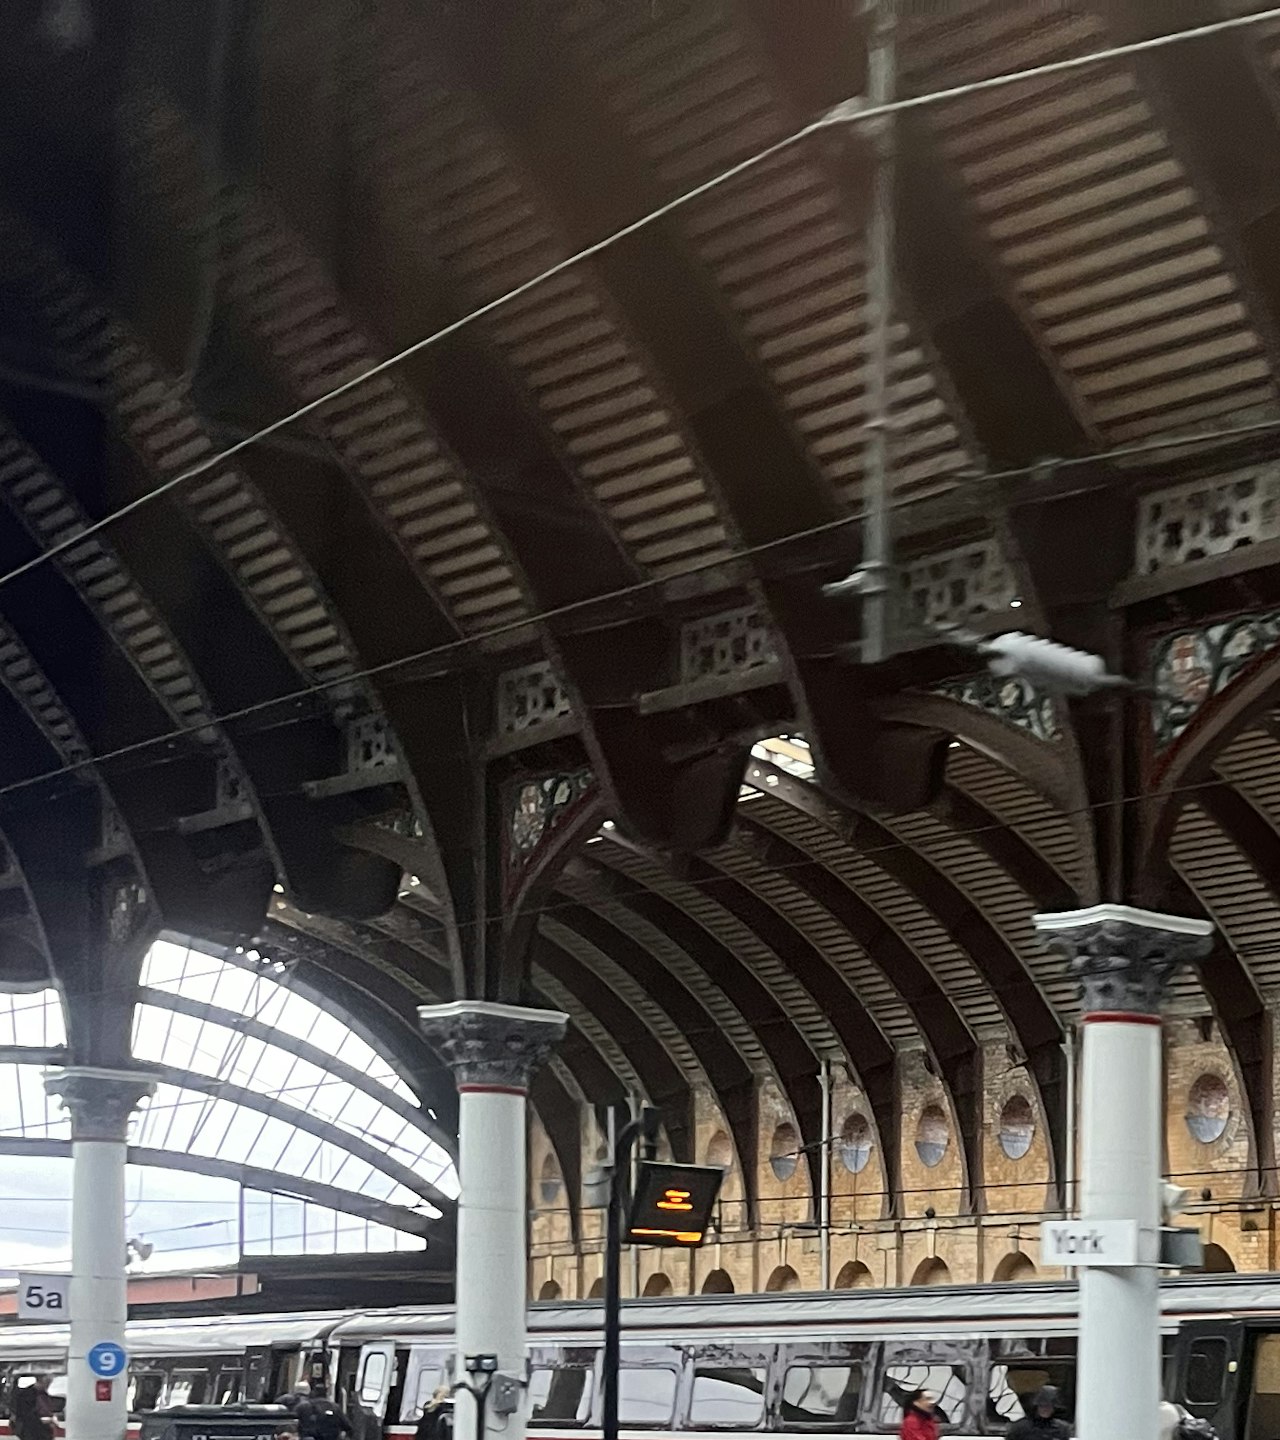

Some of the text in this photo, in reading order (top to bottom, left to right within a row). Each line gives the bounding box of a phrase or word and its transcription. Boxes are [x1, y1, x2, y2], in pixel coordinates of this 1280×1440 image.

[1050, 1229, 1105, 1254] York
[25, 1286, 63, 1309] 5a
[98, 1352, 116, 1371] 9
